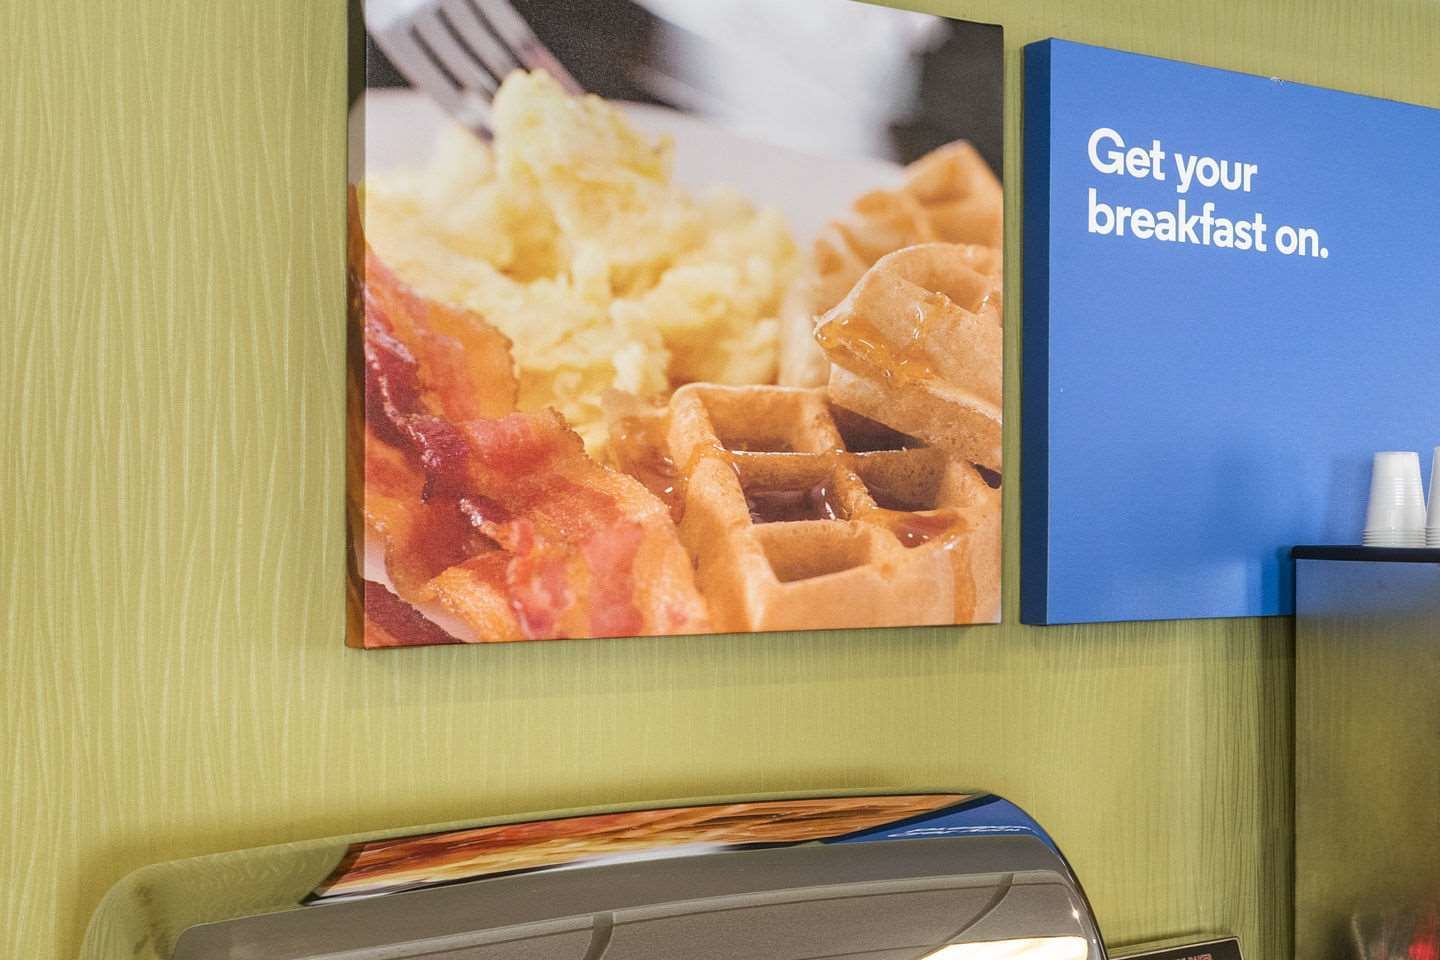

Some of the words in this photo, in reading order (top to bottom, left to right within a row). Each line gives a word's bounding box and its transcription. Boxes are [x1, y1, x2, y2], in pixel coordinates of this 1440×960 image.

[1087, 127, 1165, 181] Get
[1173, 153, 1258, 194] your
[1087, 187, 1268, 252] breakfast
[1274, 225, 1329, 259] on.
